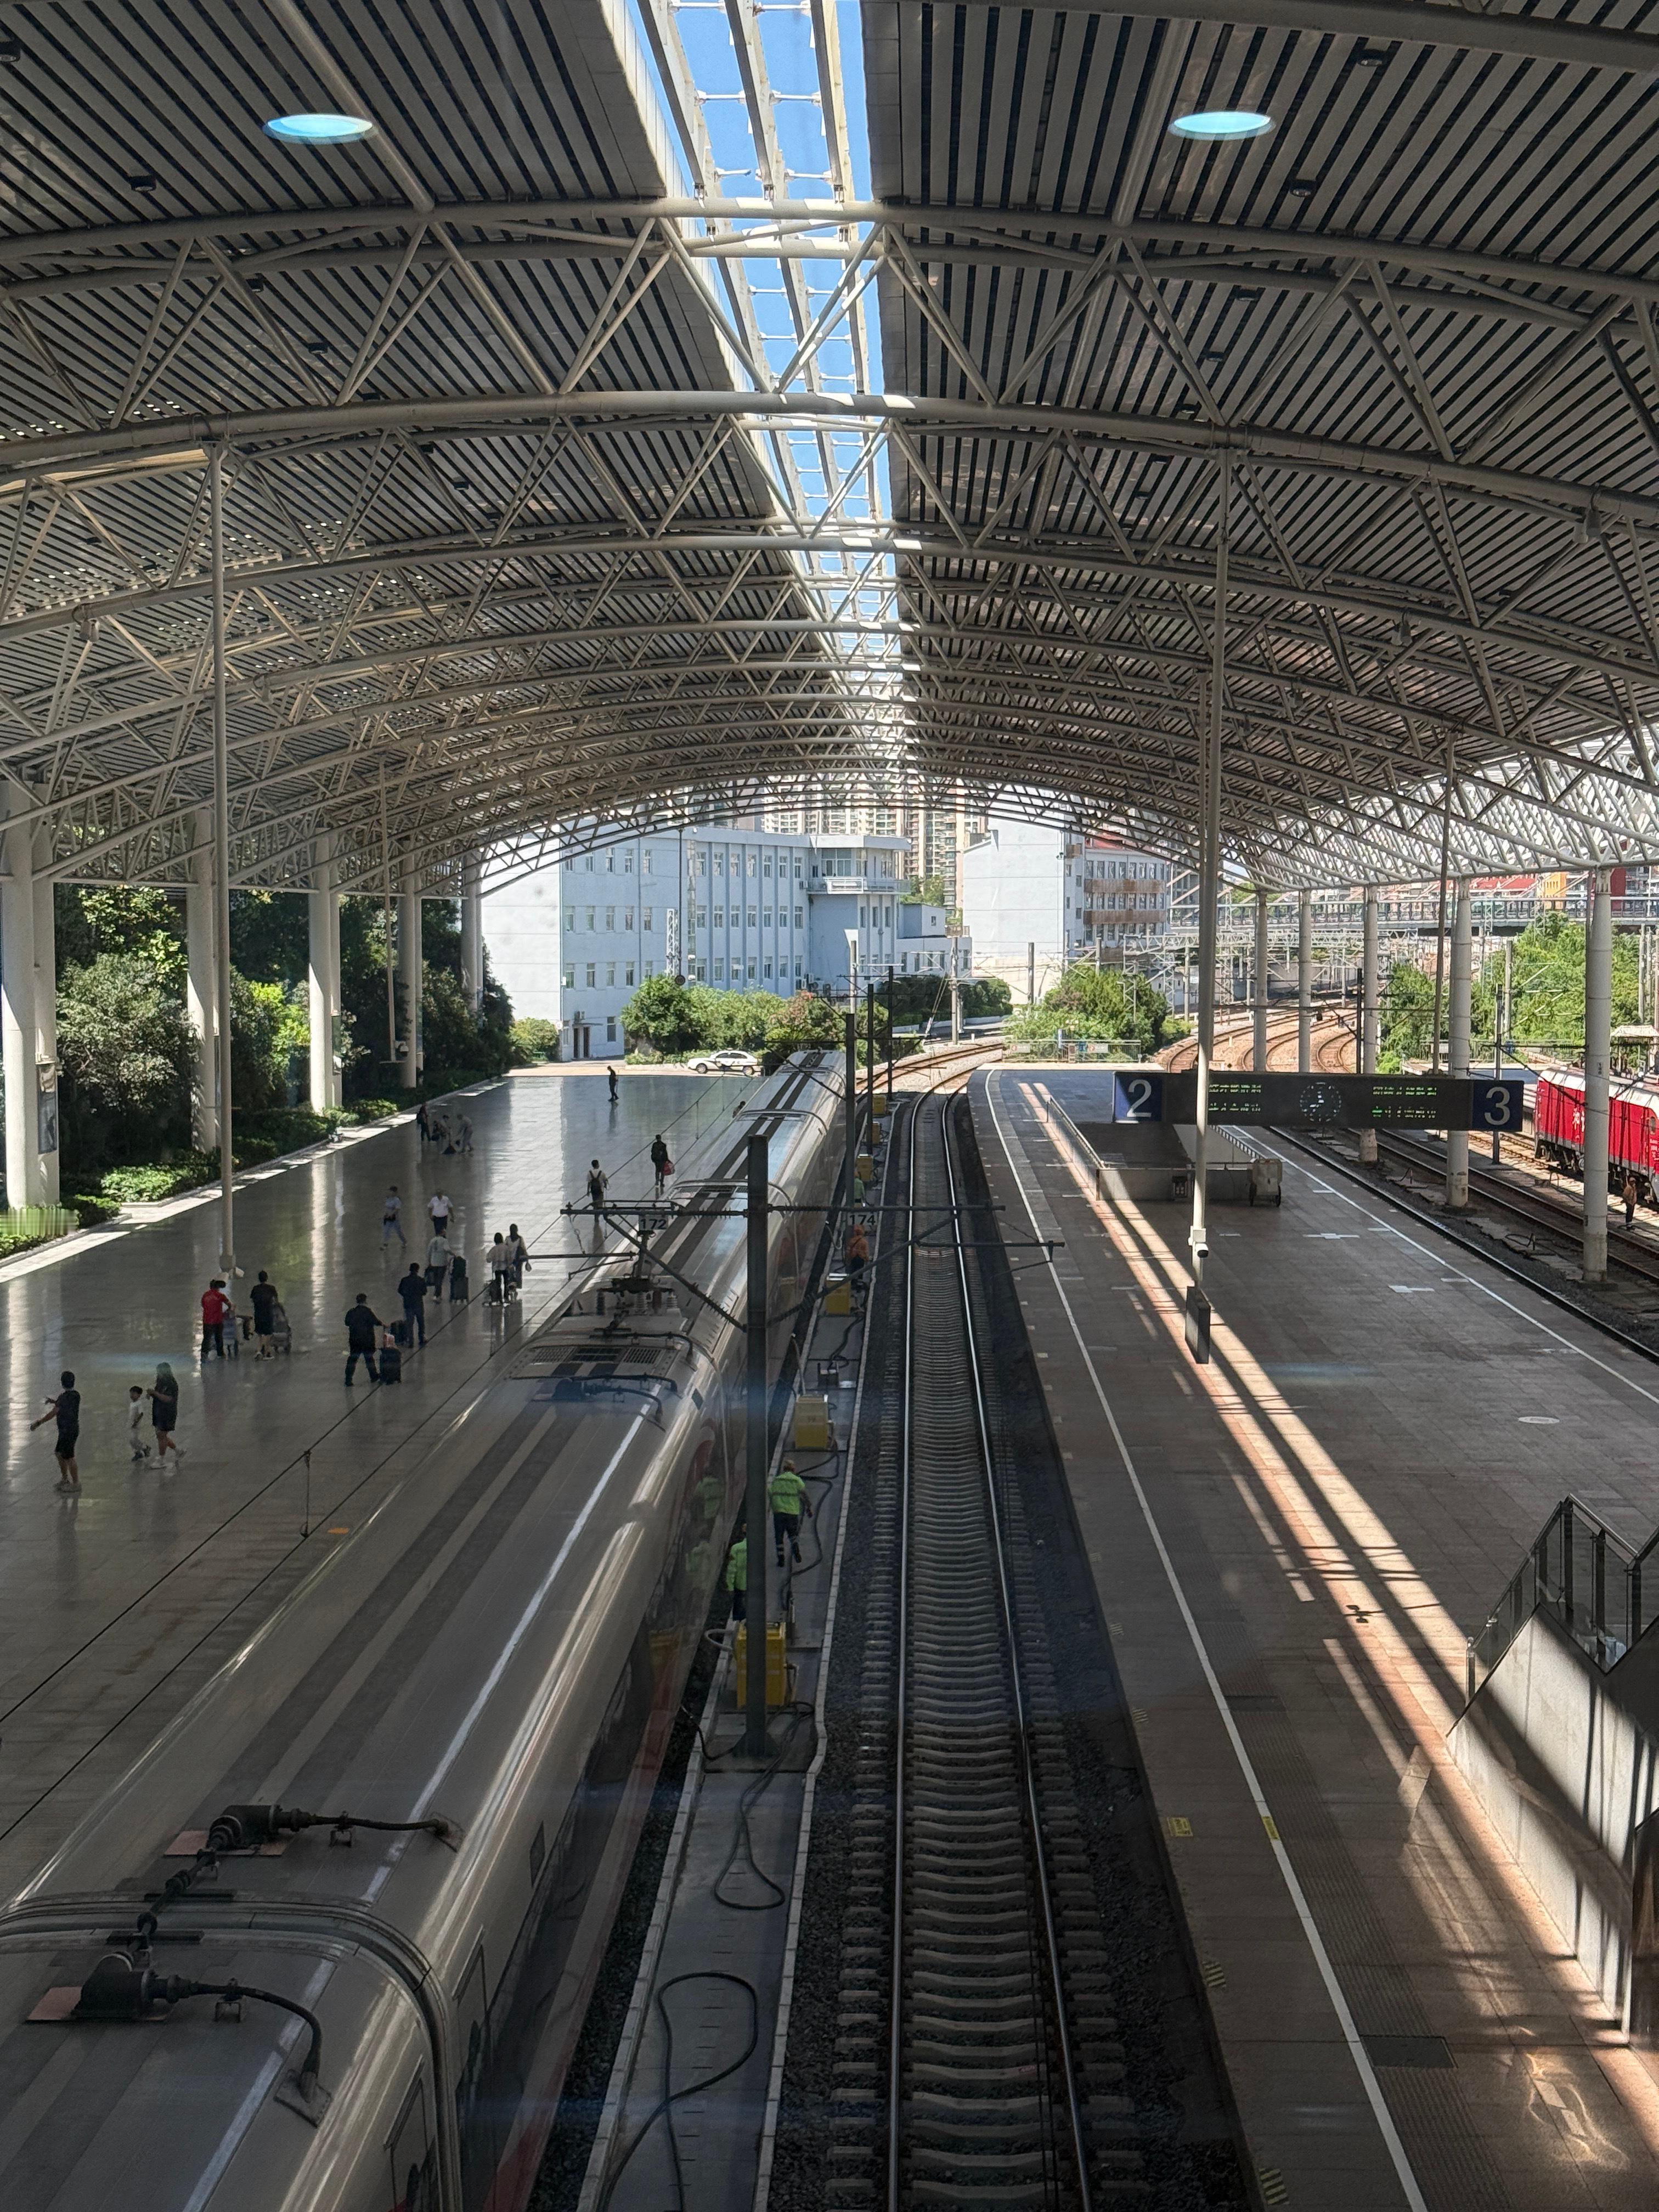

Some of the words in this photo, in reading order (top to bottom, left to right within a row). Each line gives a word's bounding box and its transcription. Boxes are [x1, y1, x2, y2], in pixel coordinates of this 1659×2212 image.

[1126, 1079, 1152, 1117] 2
[1485, 1087, 1510, 1125] 3
[640, 1218, 667, 1229] 172
[850, 1215, 876, 1225] 174
